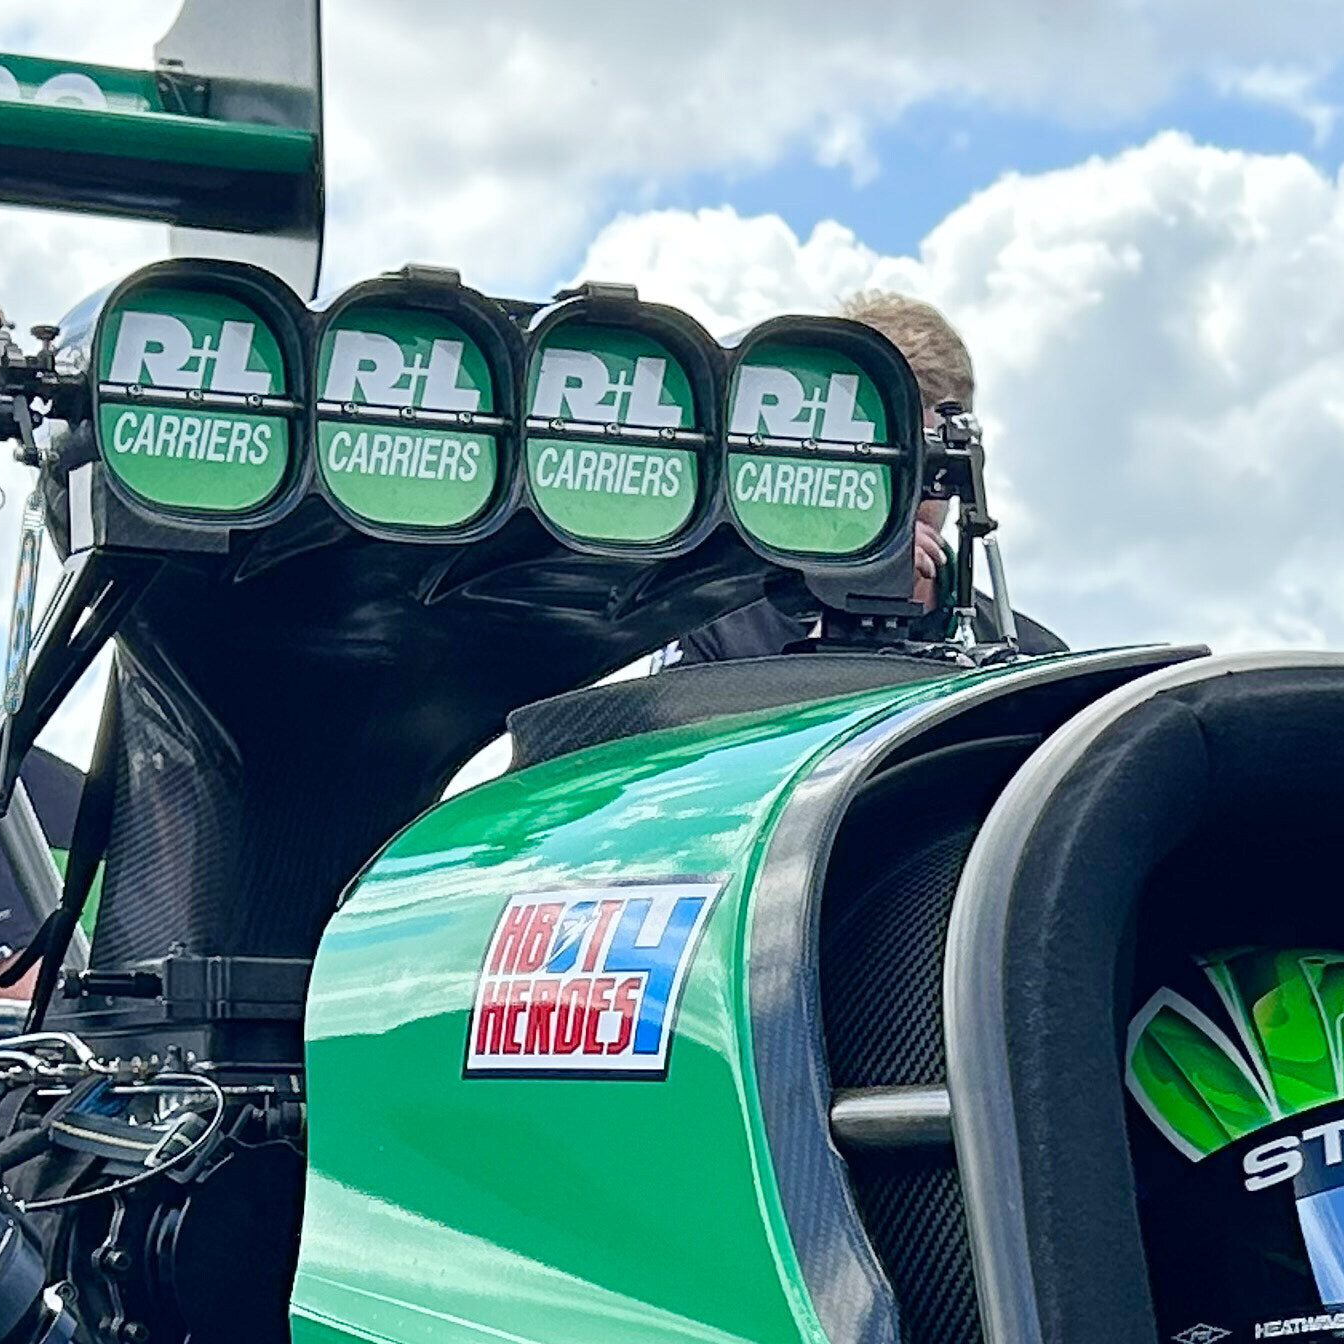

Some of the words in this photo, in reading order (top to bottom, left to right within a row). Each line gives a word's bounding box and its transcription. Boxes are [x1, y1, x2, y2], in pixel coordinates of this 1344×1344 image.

[113, 411, 272, 466] CARRIERS
[328, 430, 481, 483] CARRIERS
[535, 446, 683, 499] CARRIERS
[735, 460, 878, 512] CARRIERS
[474, 977, 644, 1056] HEROES
